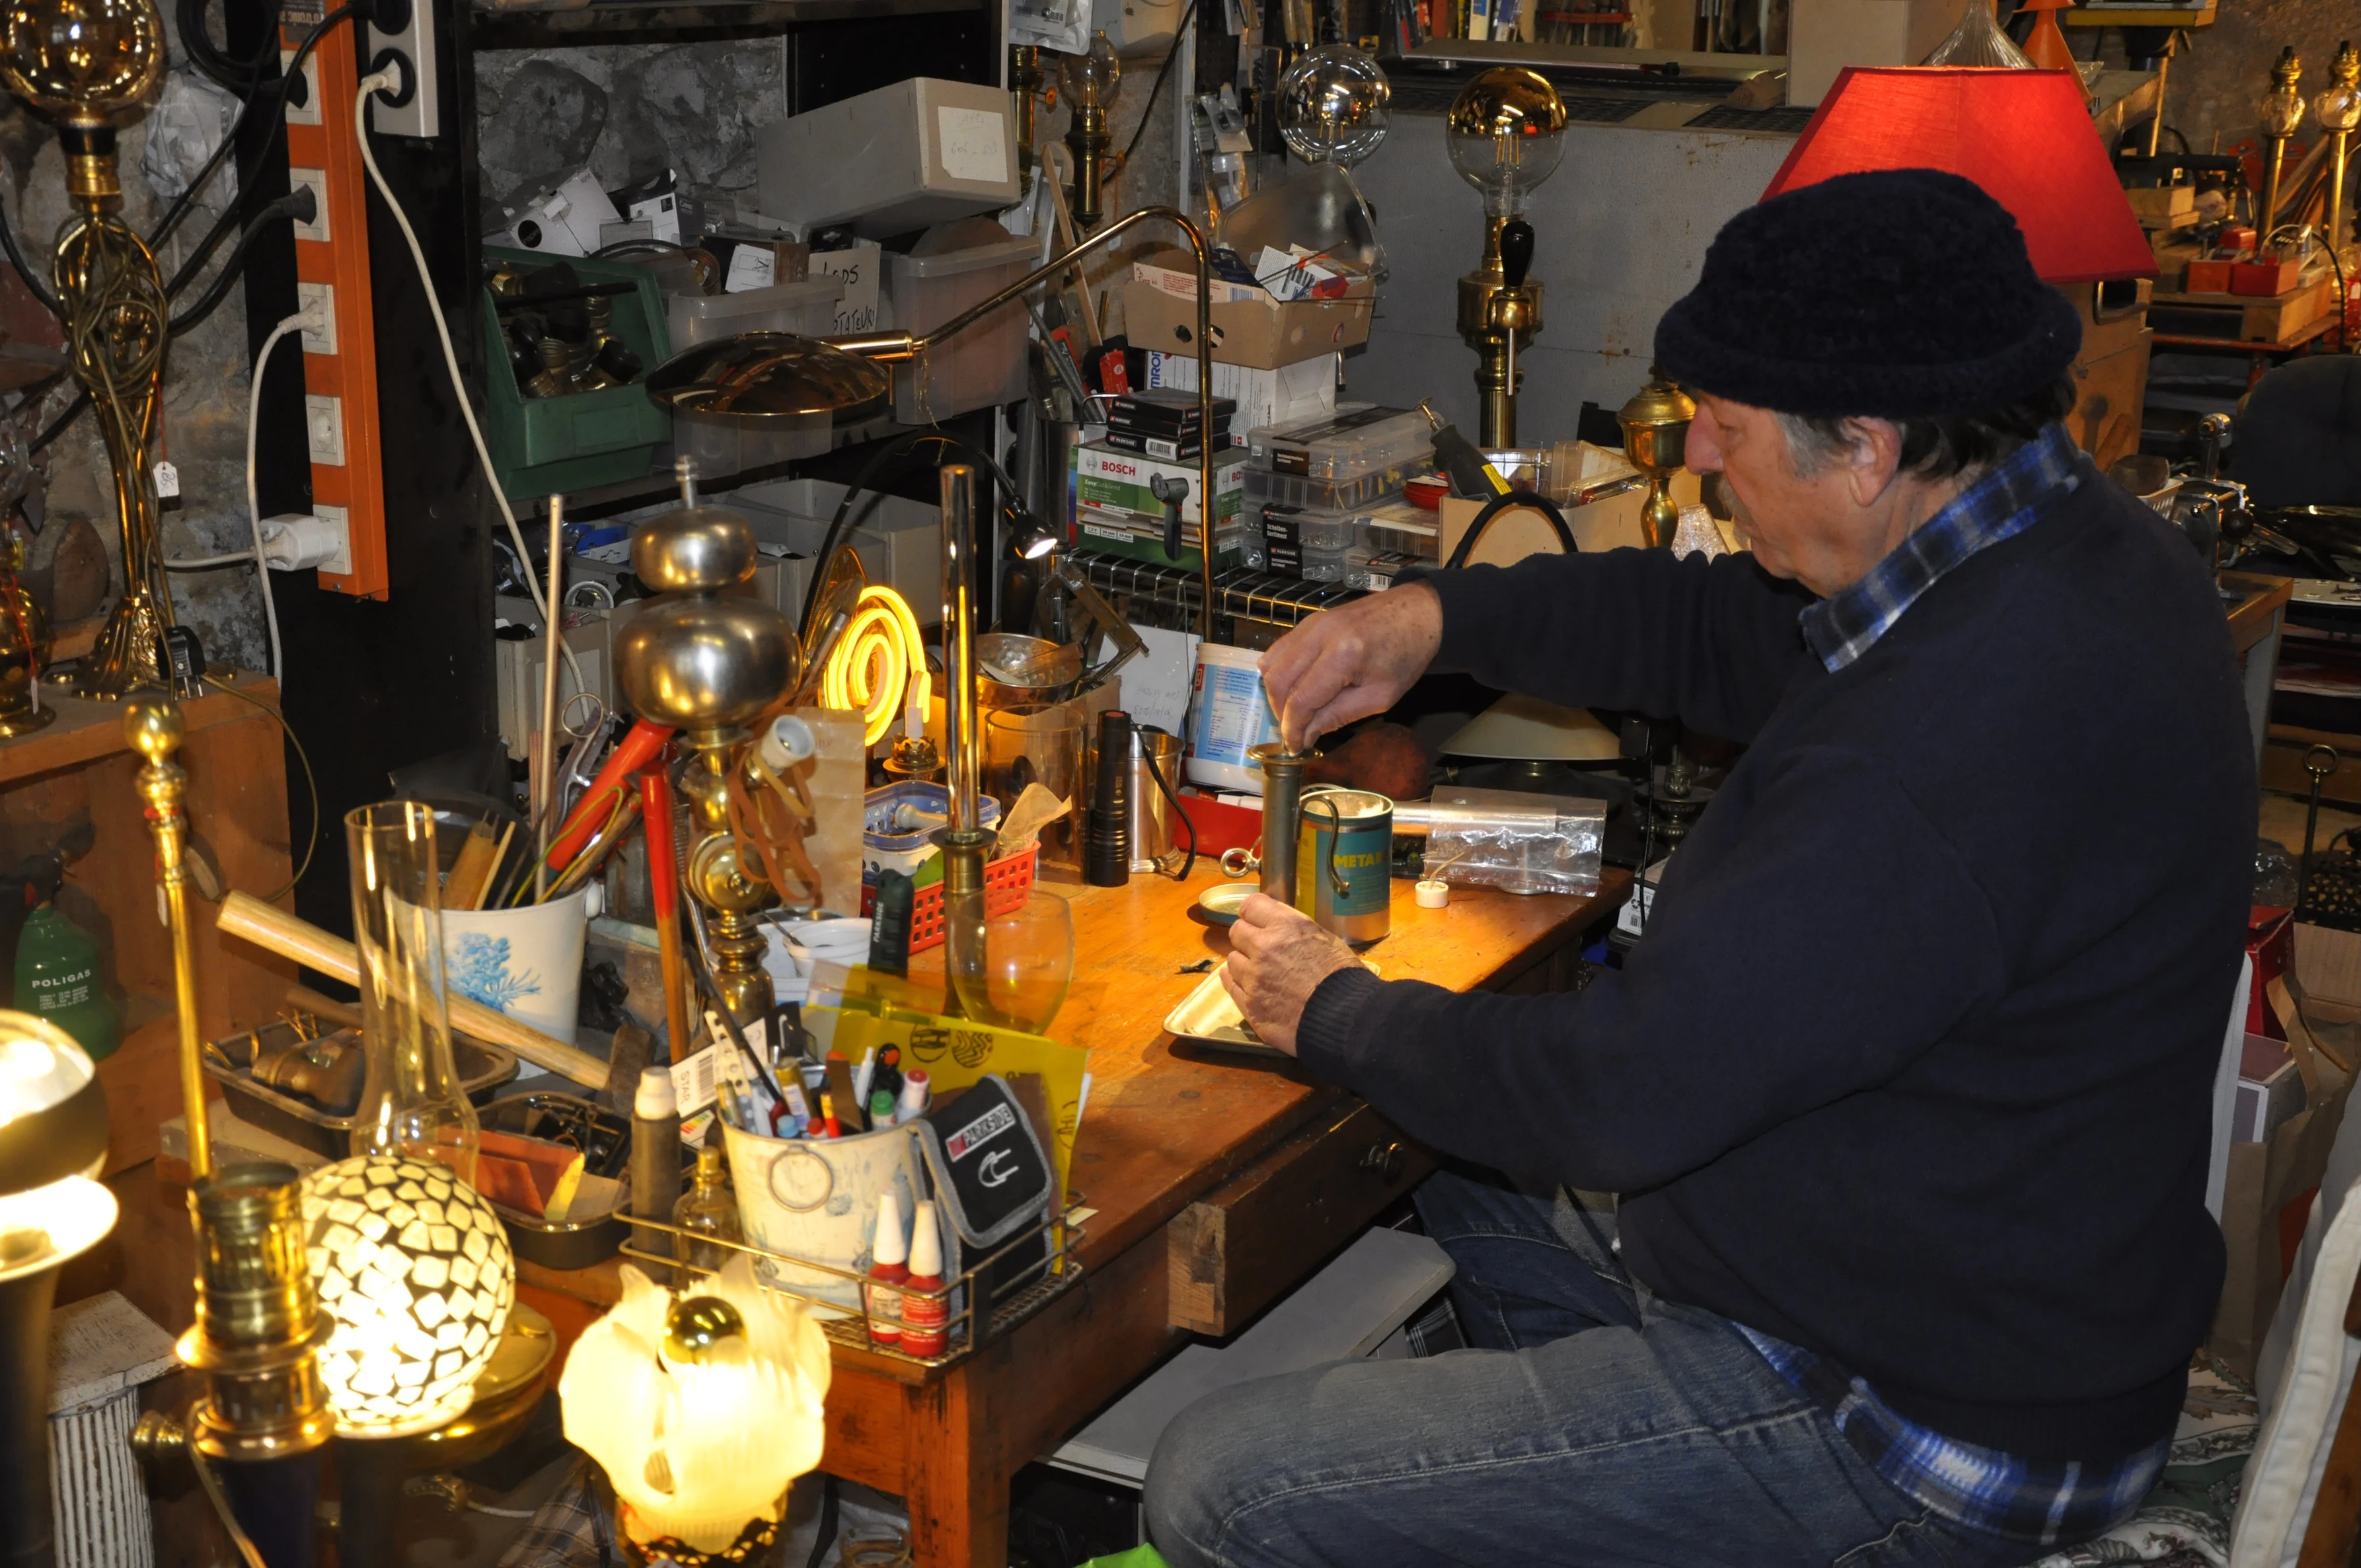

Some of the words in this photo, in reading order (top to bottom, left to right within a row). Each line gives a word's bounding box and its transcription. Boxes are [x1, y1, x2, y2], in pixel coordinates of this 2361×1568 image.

[1115, 437, 1135, 447] PARKSIDE
[1102, 461, 1136, 476] BOSCH
[1267, 523, 1288, 533] Scheiben-
[1267, 530, 1287, 540] Sortiment
[872, 901, 884, 943] PARKSIDE
[32, 969, 91, 989] POLIGAS
[963, 1106, 1014, 1148] PARKSIDE
